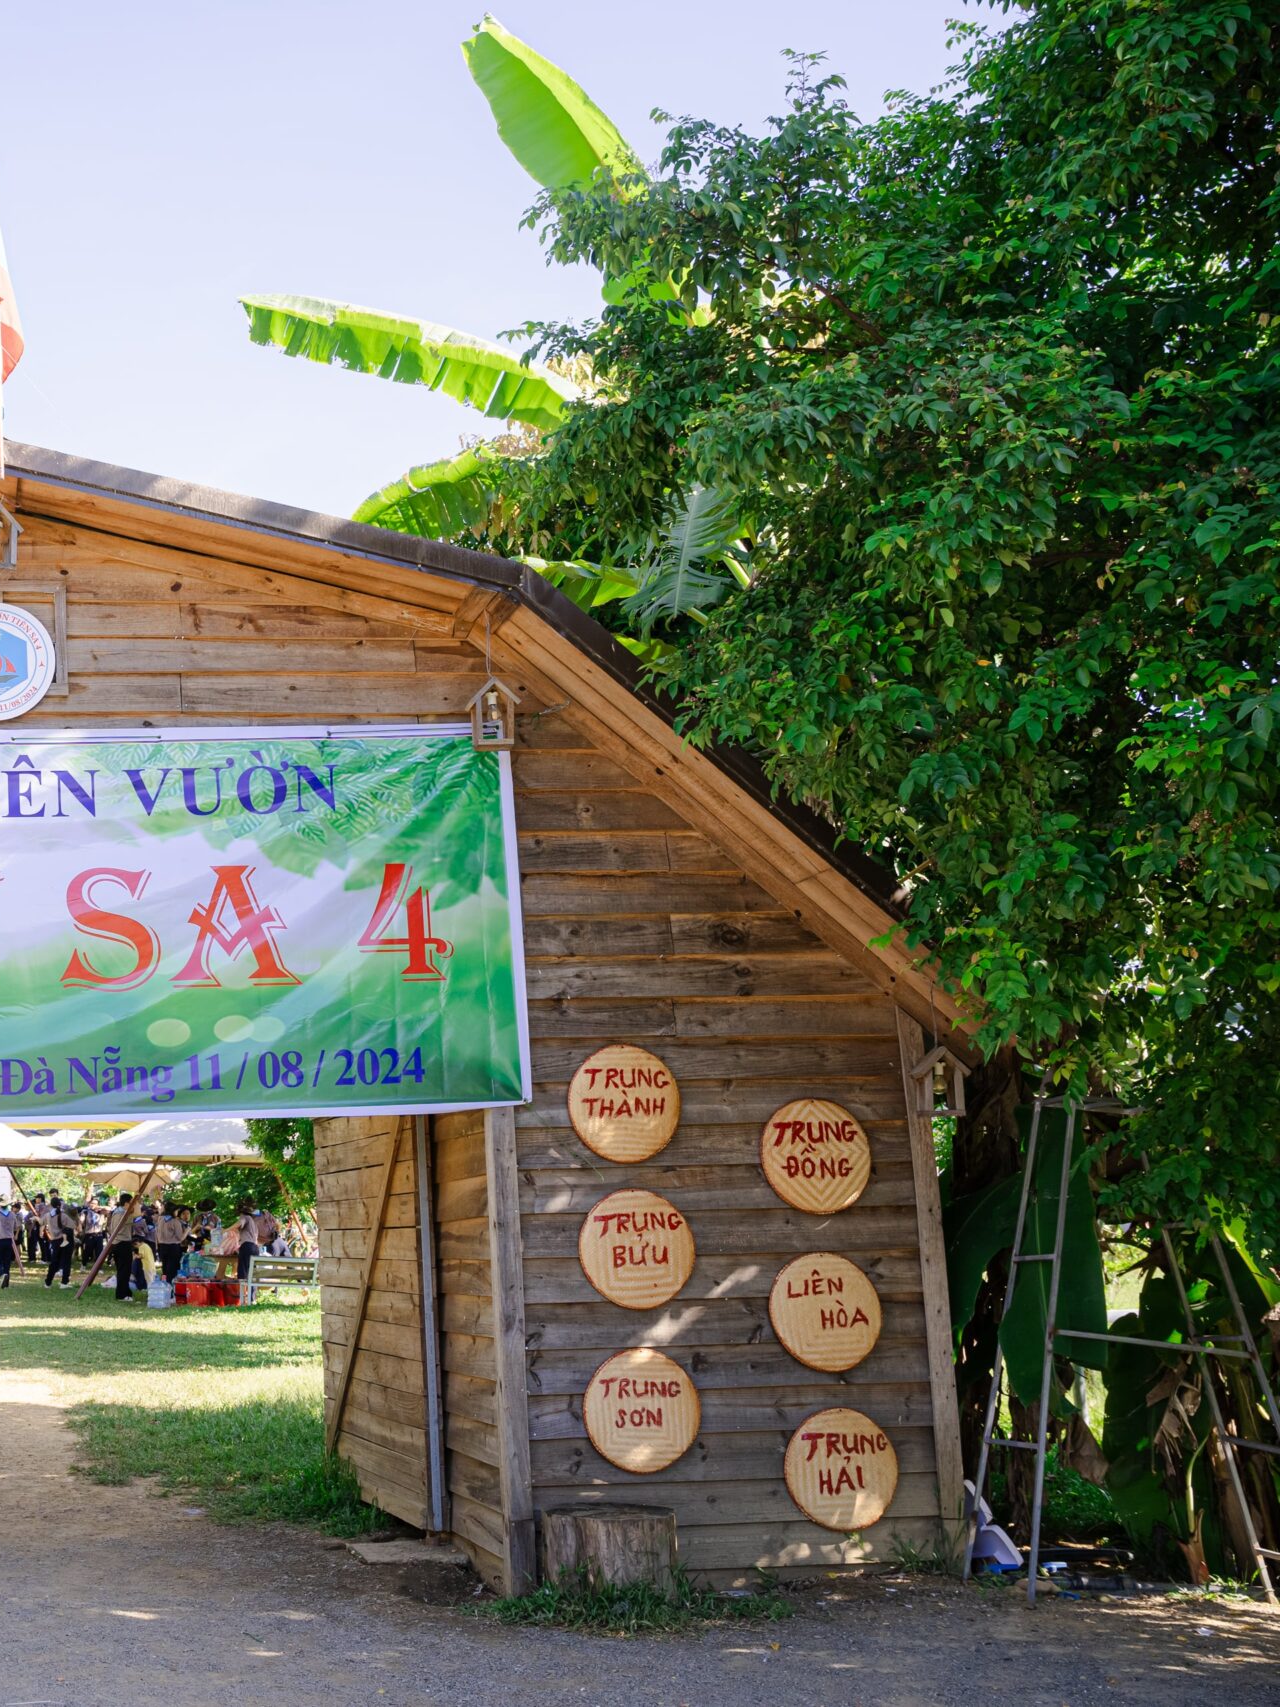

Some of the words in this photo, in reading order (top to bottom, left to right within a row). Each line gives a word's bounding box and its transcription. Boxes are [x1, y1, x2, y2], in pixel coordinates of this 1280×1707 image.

[123, 750, 339, 816] VƯỜN
[60, 864, 303, 993] SA
[357, 863, 455, 983] 4
[66, 1046, 175, 1103] Nẵng
[583, 1067, 670, 1091] TRUNG
[582, 1090, 665, 1119] THÀNH
[772, 1120, 858, 1147] TRUNG
[781, 1144, 853, 1179] ĐỒNG
[593, 1212, 683, 1238] TRUNG
[612, 1232, 669, 1268] BỬU
[787, 1269, 843, 1298] LIÊN
[820, 1300, 870, 1330] HÒA
[599, 1377, 681, 1400] TRUNG
[801, 1432, 888, 1462] TRUNG
[819, 1456, 866, 1496] HẢI
